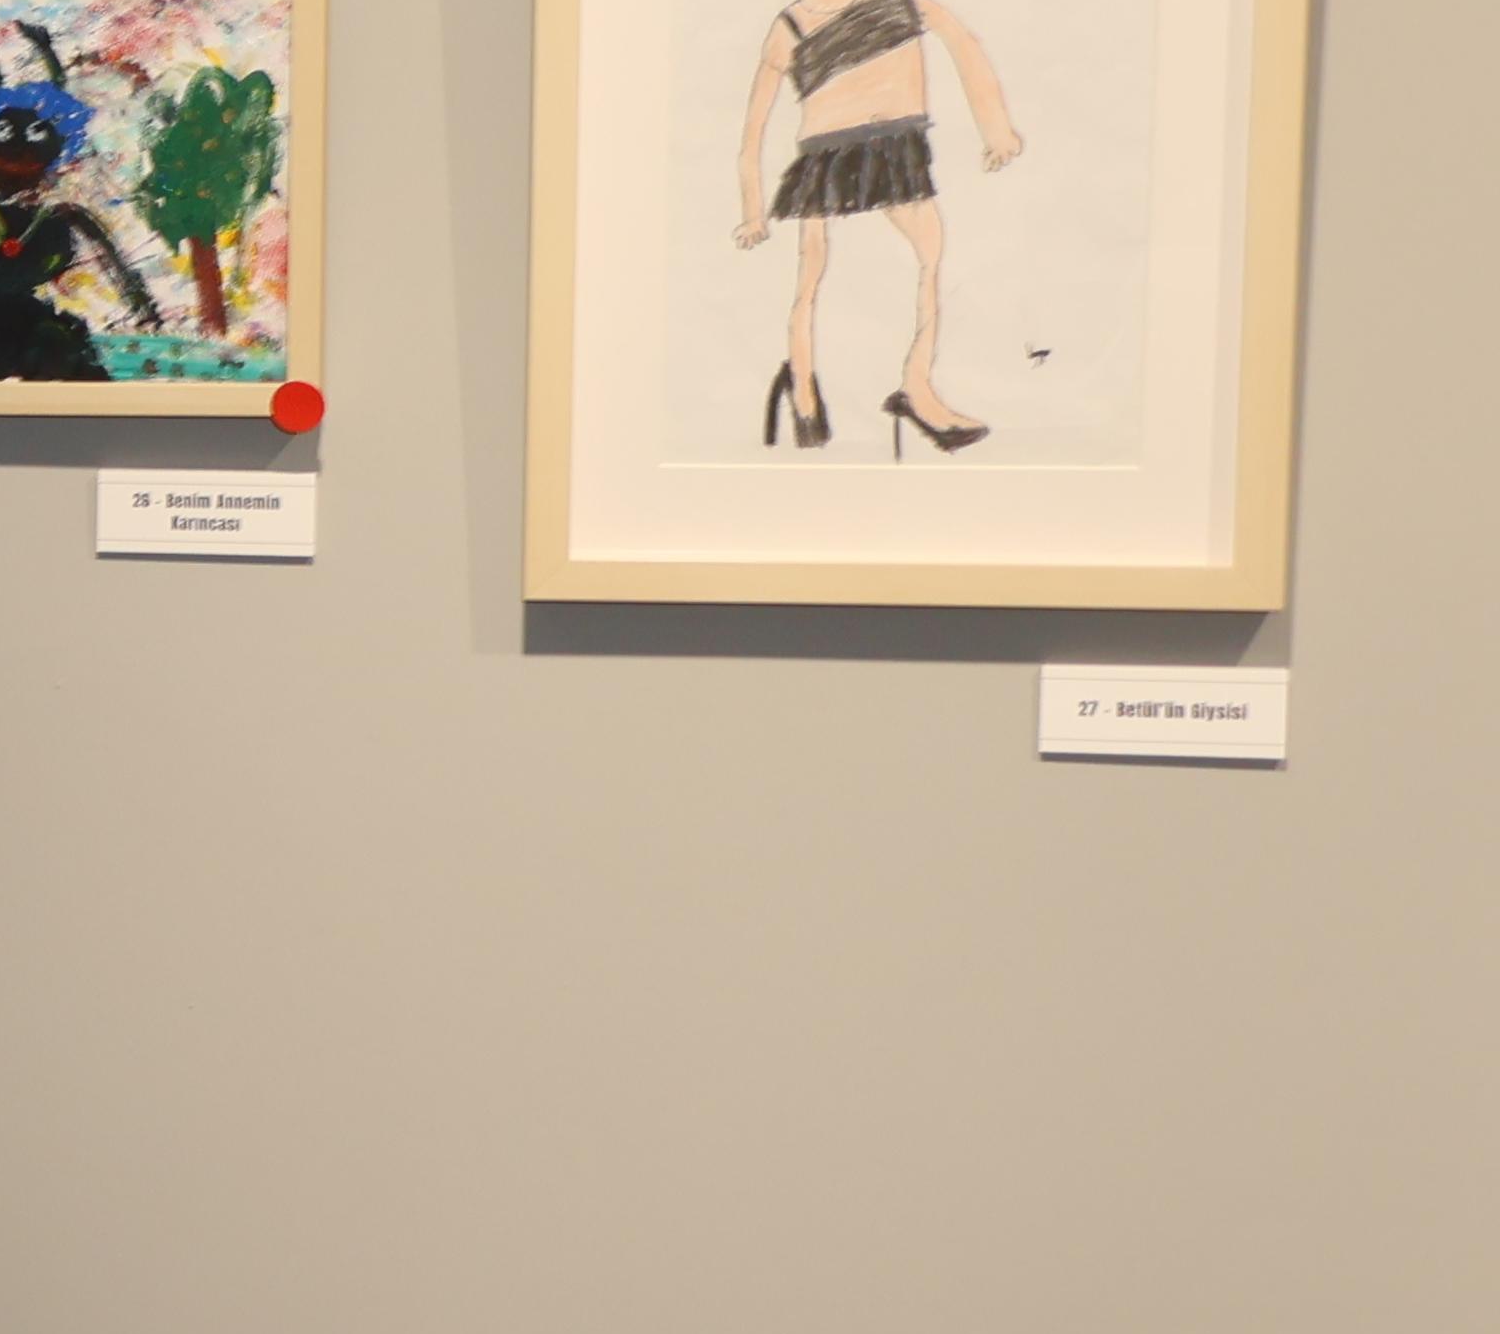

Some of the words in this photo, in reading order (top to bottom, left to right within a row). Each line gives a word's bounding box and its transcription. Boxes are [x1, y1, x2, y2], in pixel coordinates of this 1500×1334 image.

[166, 493, 212, 510] Benim
[216, 494, 281, 511] Annemin
[1078, 700, 1099, 717] 27
[1191, 702, 1248, 721] Giysisi
